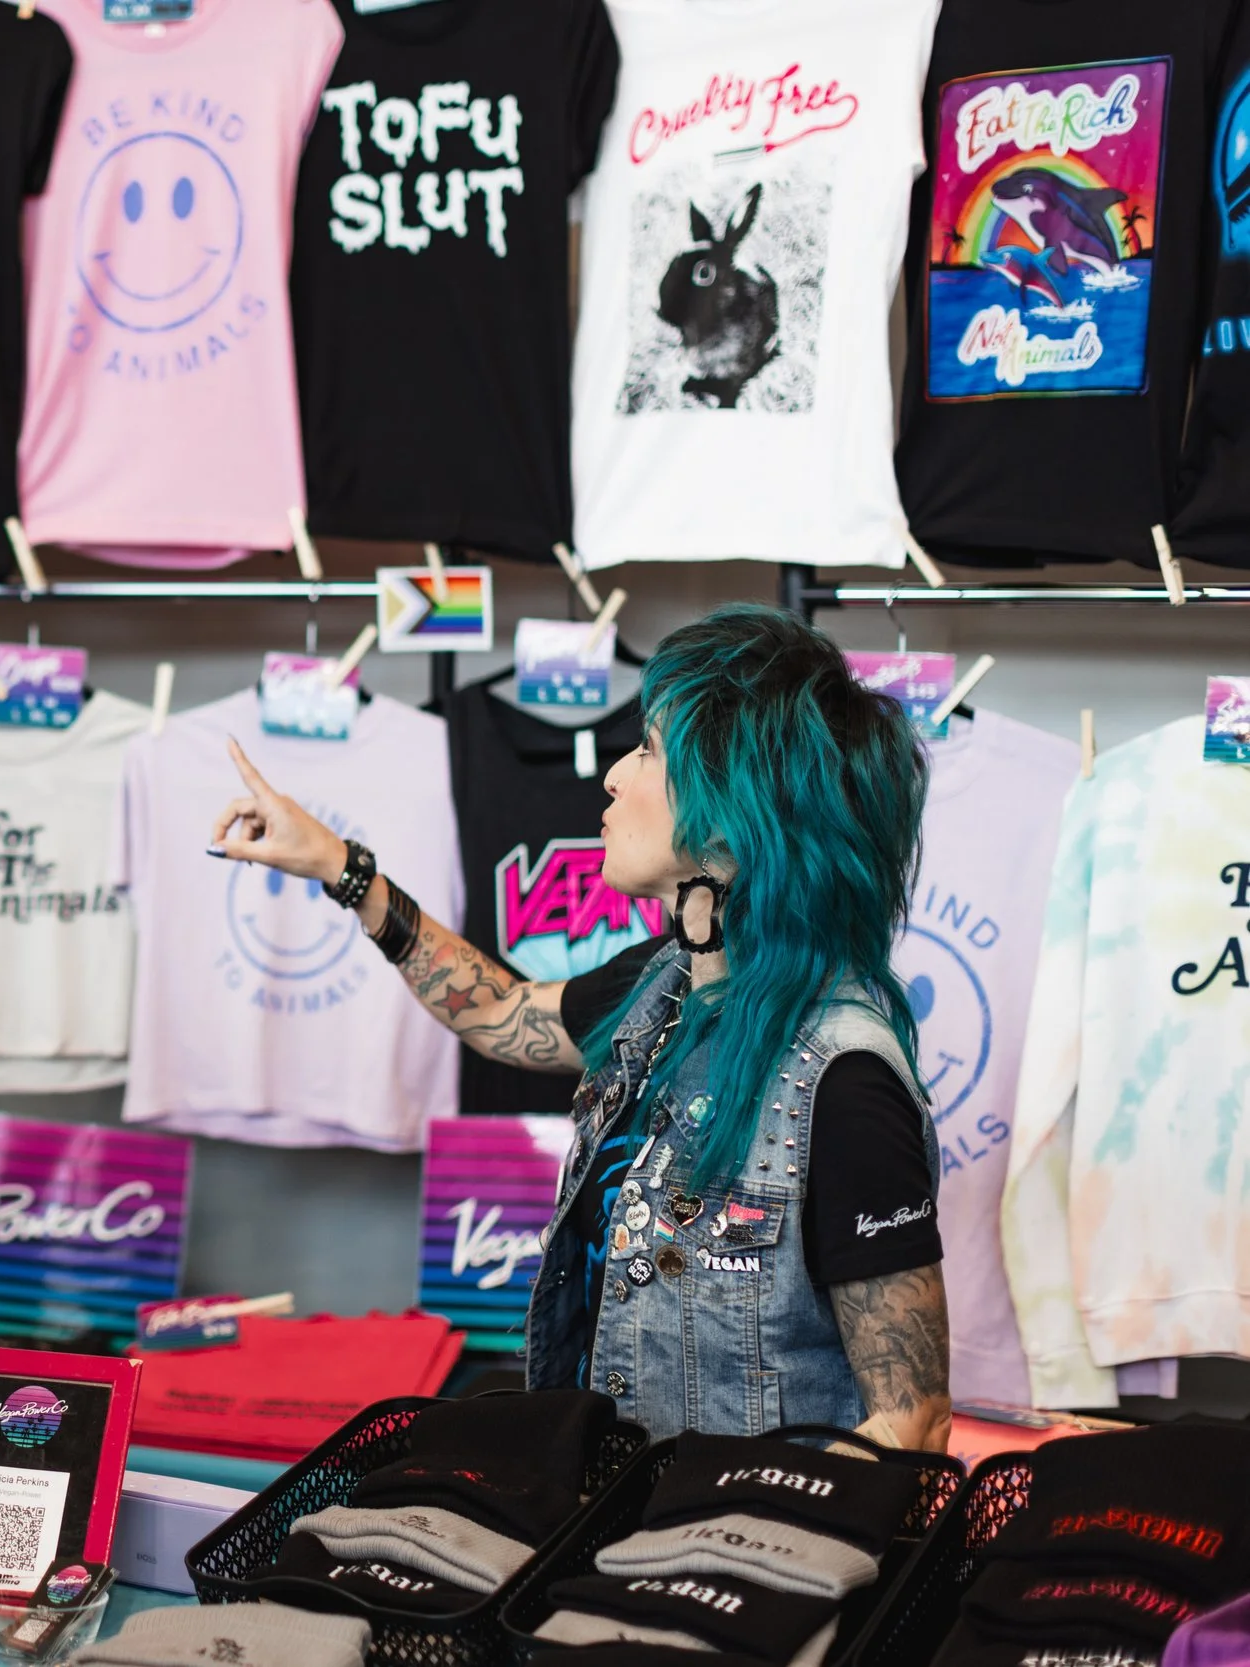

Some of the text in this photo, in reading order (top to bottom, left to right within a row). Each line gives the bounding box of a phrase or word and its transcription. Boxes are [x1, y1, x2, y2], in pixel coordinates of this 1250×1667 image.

[82, 92, 246, 146] BE KIND
[629, 62, 850, 165] Cruelty Free
[966, 96, 1018, 160] Eat
[1058, 83, 1132, 147] Rich
[922, 884, 1002, 952] IND
[698, 1253, 761, 1272] VEGAN
[15, 1475, 50, 1488] Perkins
